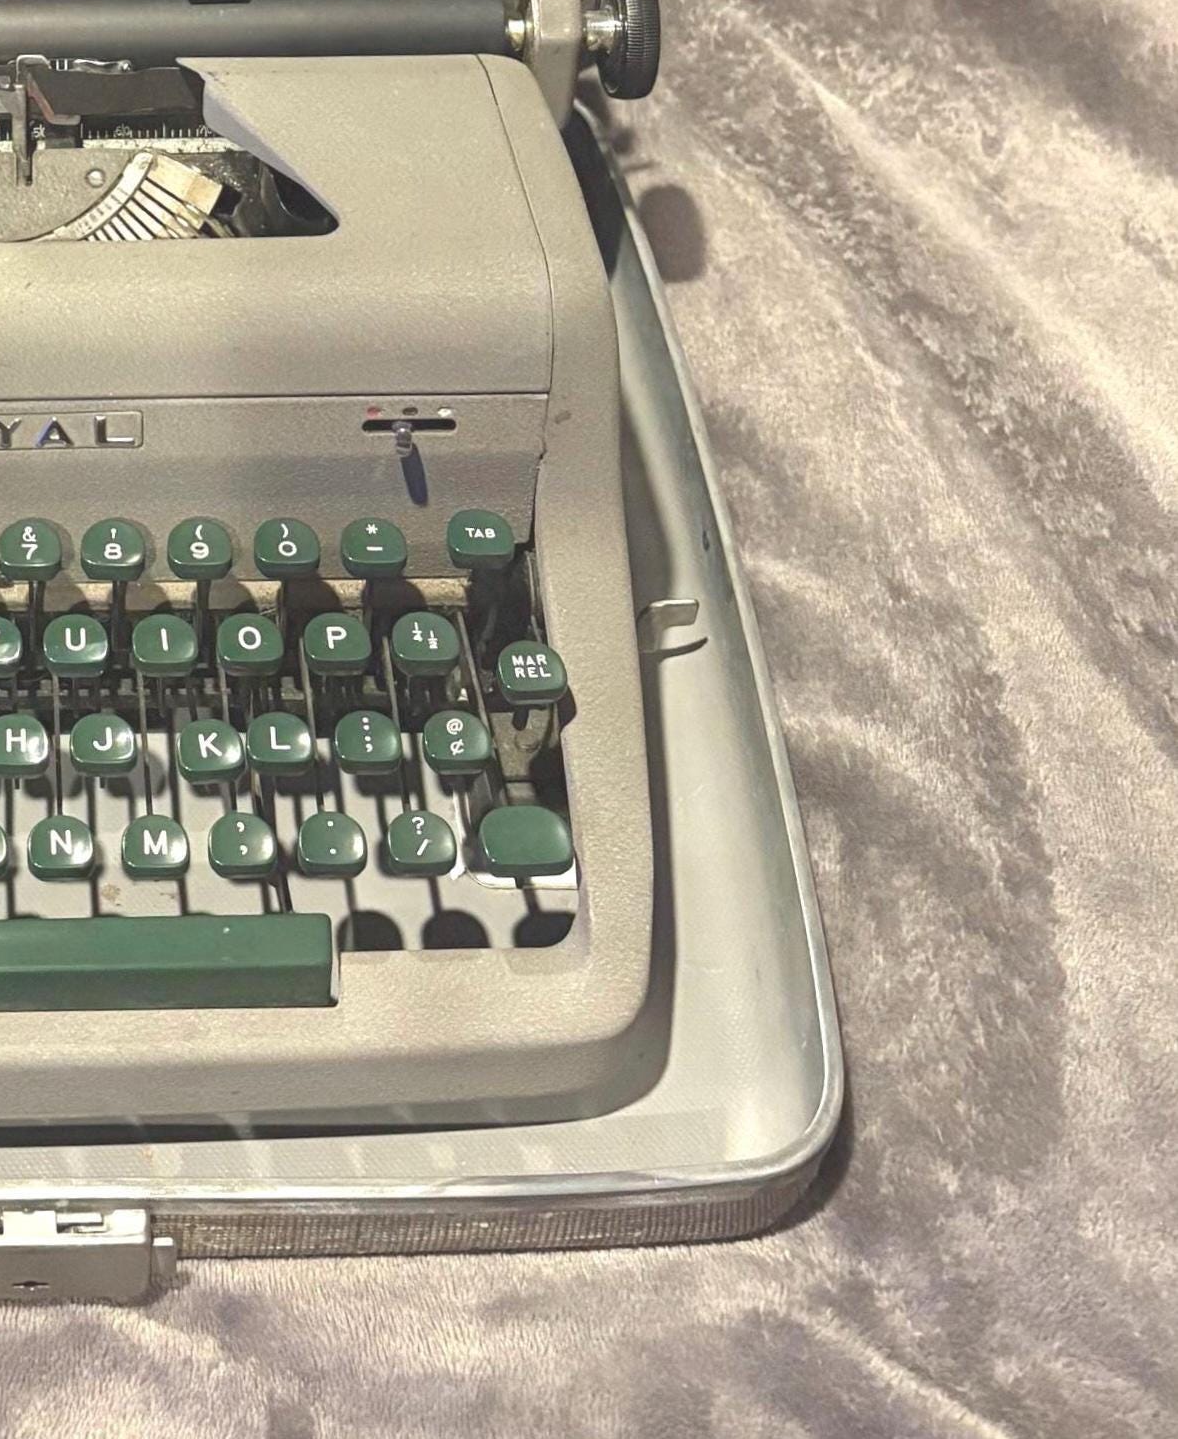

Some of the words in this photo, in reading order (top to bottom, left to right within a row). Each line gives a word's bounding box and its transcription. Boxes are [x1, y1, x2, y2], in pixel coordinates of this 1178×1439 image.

[22, 526, 36, 542] &
[465, 528, 496, 538] TAB
[21, 544, 37, 559] 7
[105, 543, 121, 559] 8
[190, 542, 209, 559] 9
[65, 628, 85, 651] U
[238, 626, 261, 649] O
[327, 626, 347, 648] P
[512, 654, 547, 666] MAR
[514, 666, 551, 678] REL
[446, 718, 463, 735] @
[6, 728, 27, 753] H
[92, 727, 113, 751] J
[199, 733, 221, 757] K
[270, 727, 291, 750] L
[412, 816, 425, 834] ?
[50, 830, 72, 854] N
[144, 830, 168, 854] M
